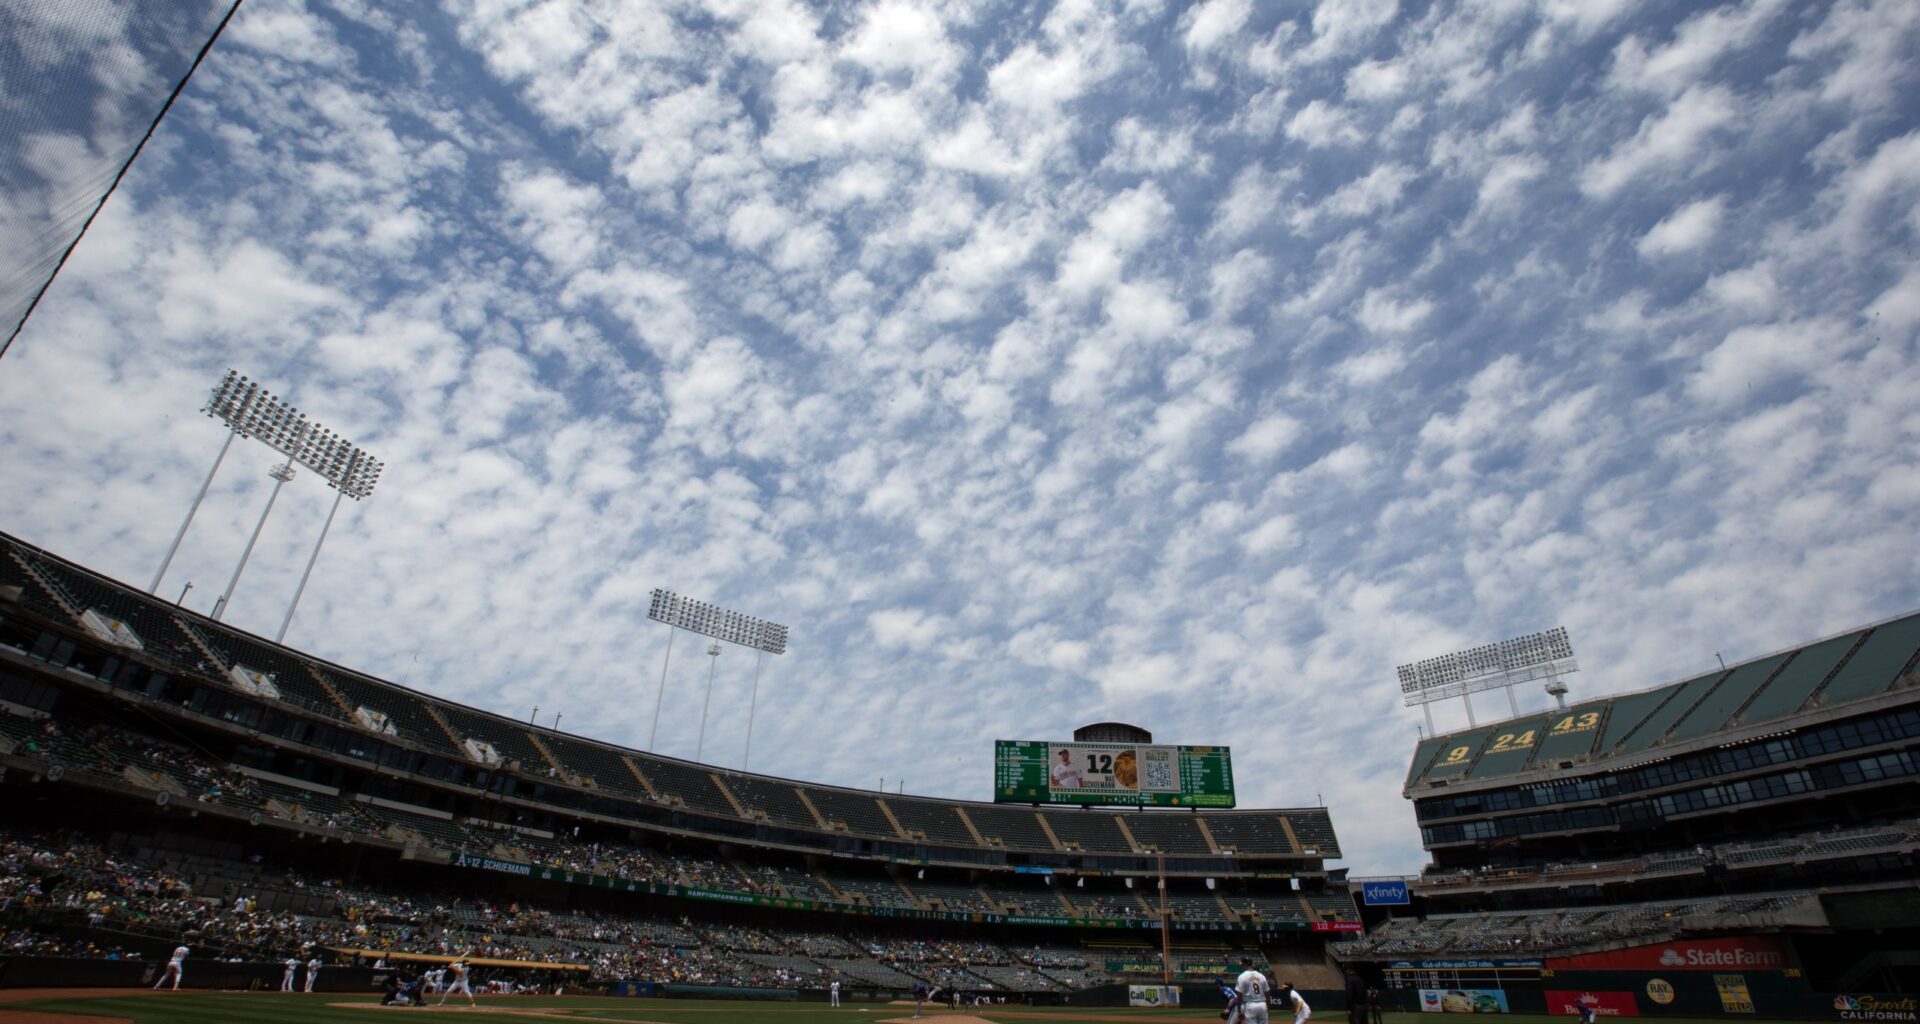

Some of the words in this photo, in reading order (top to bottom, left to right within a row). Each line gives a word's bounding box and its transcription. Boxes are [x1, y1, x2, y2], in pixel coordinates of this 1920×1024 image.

[1554, 712, 1600, 730] 43
[1493, 730, 1536, 750] 24
[1447, 746, 1470, 762] 9
[1087, 754, 1113, 774] 12
[471, 857, 481, 867] 12
[482, 859, 531, 876] SCHUEMANN
[1367, 886, 1404, 900] xfinity
[1130, 990, 1145, 1000] Call
[1252, 983, 1260, 995] 8
[1649, 983, 1667, 993] RAY
[1564, 1004, 1620, 1015] Bueiser
[1857, 995, 1917, 1011] Sports
[1840, 1011, 1917, 1021] CALIFORNIA
